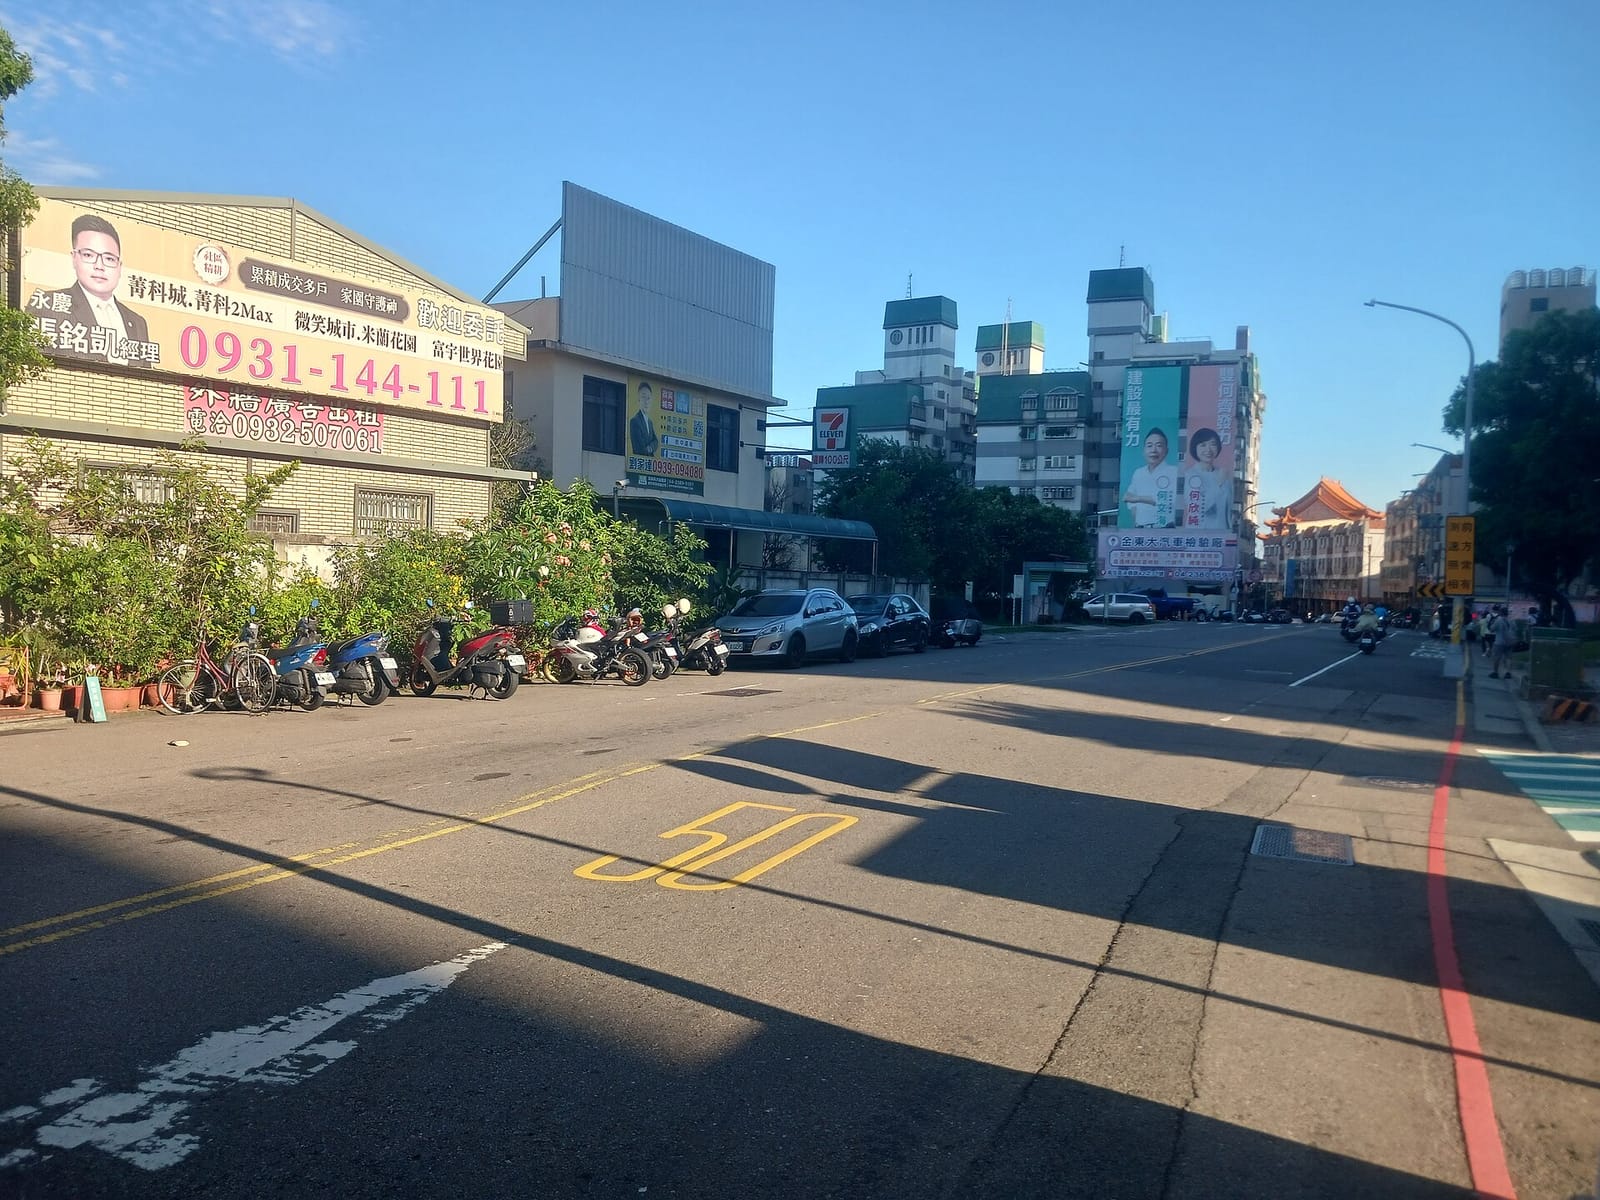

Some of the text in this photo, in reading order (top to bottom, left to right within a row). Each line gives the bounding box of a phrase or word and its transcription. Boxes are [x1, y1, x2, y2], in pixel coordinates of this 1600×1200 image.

[203, 250, 222, 264] 社區
[30, 288, 73, 314] 永慶
[250, 265, 398, 315] 累積成交多戶 家園守護神
[417, 298, 504, 345] 歡迎委託
[180, 325, 489, 414] 0931-144-111
[432, 340, 503, 370] 富宇世界花園
[1125, 369, 1143, 447] 建設最有力
[573, 800, 859, 892] 50
